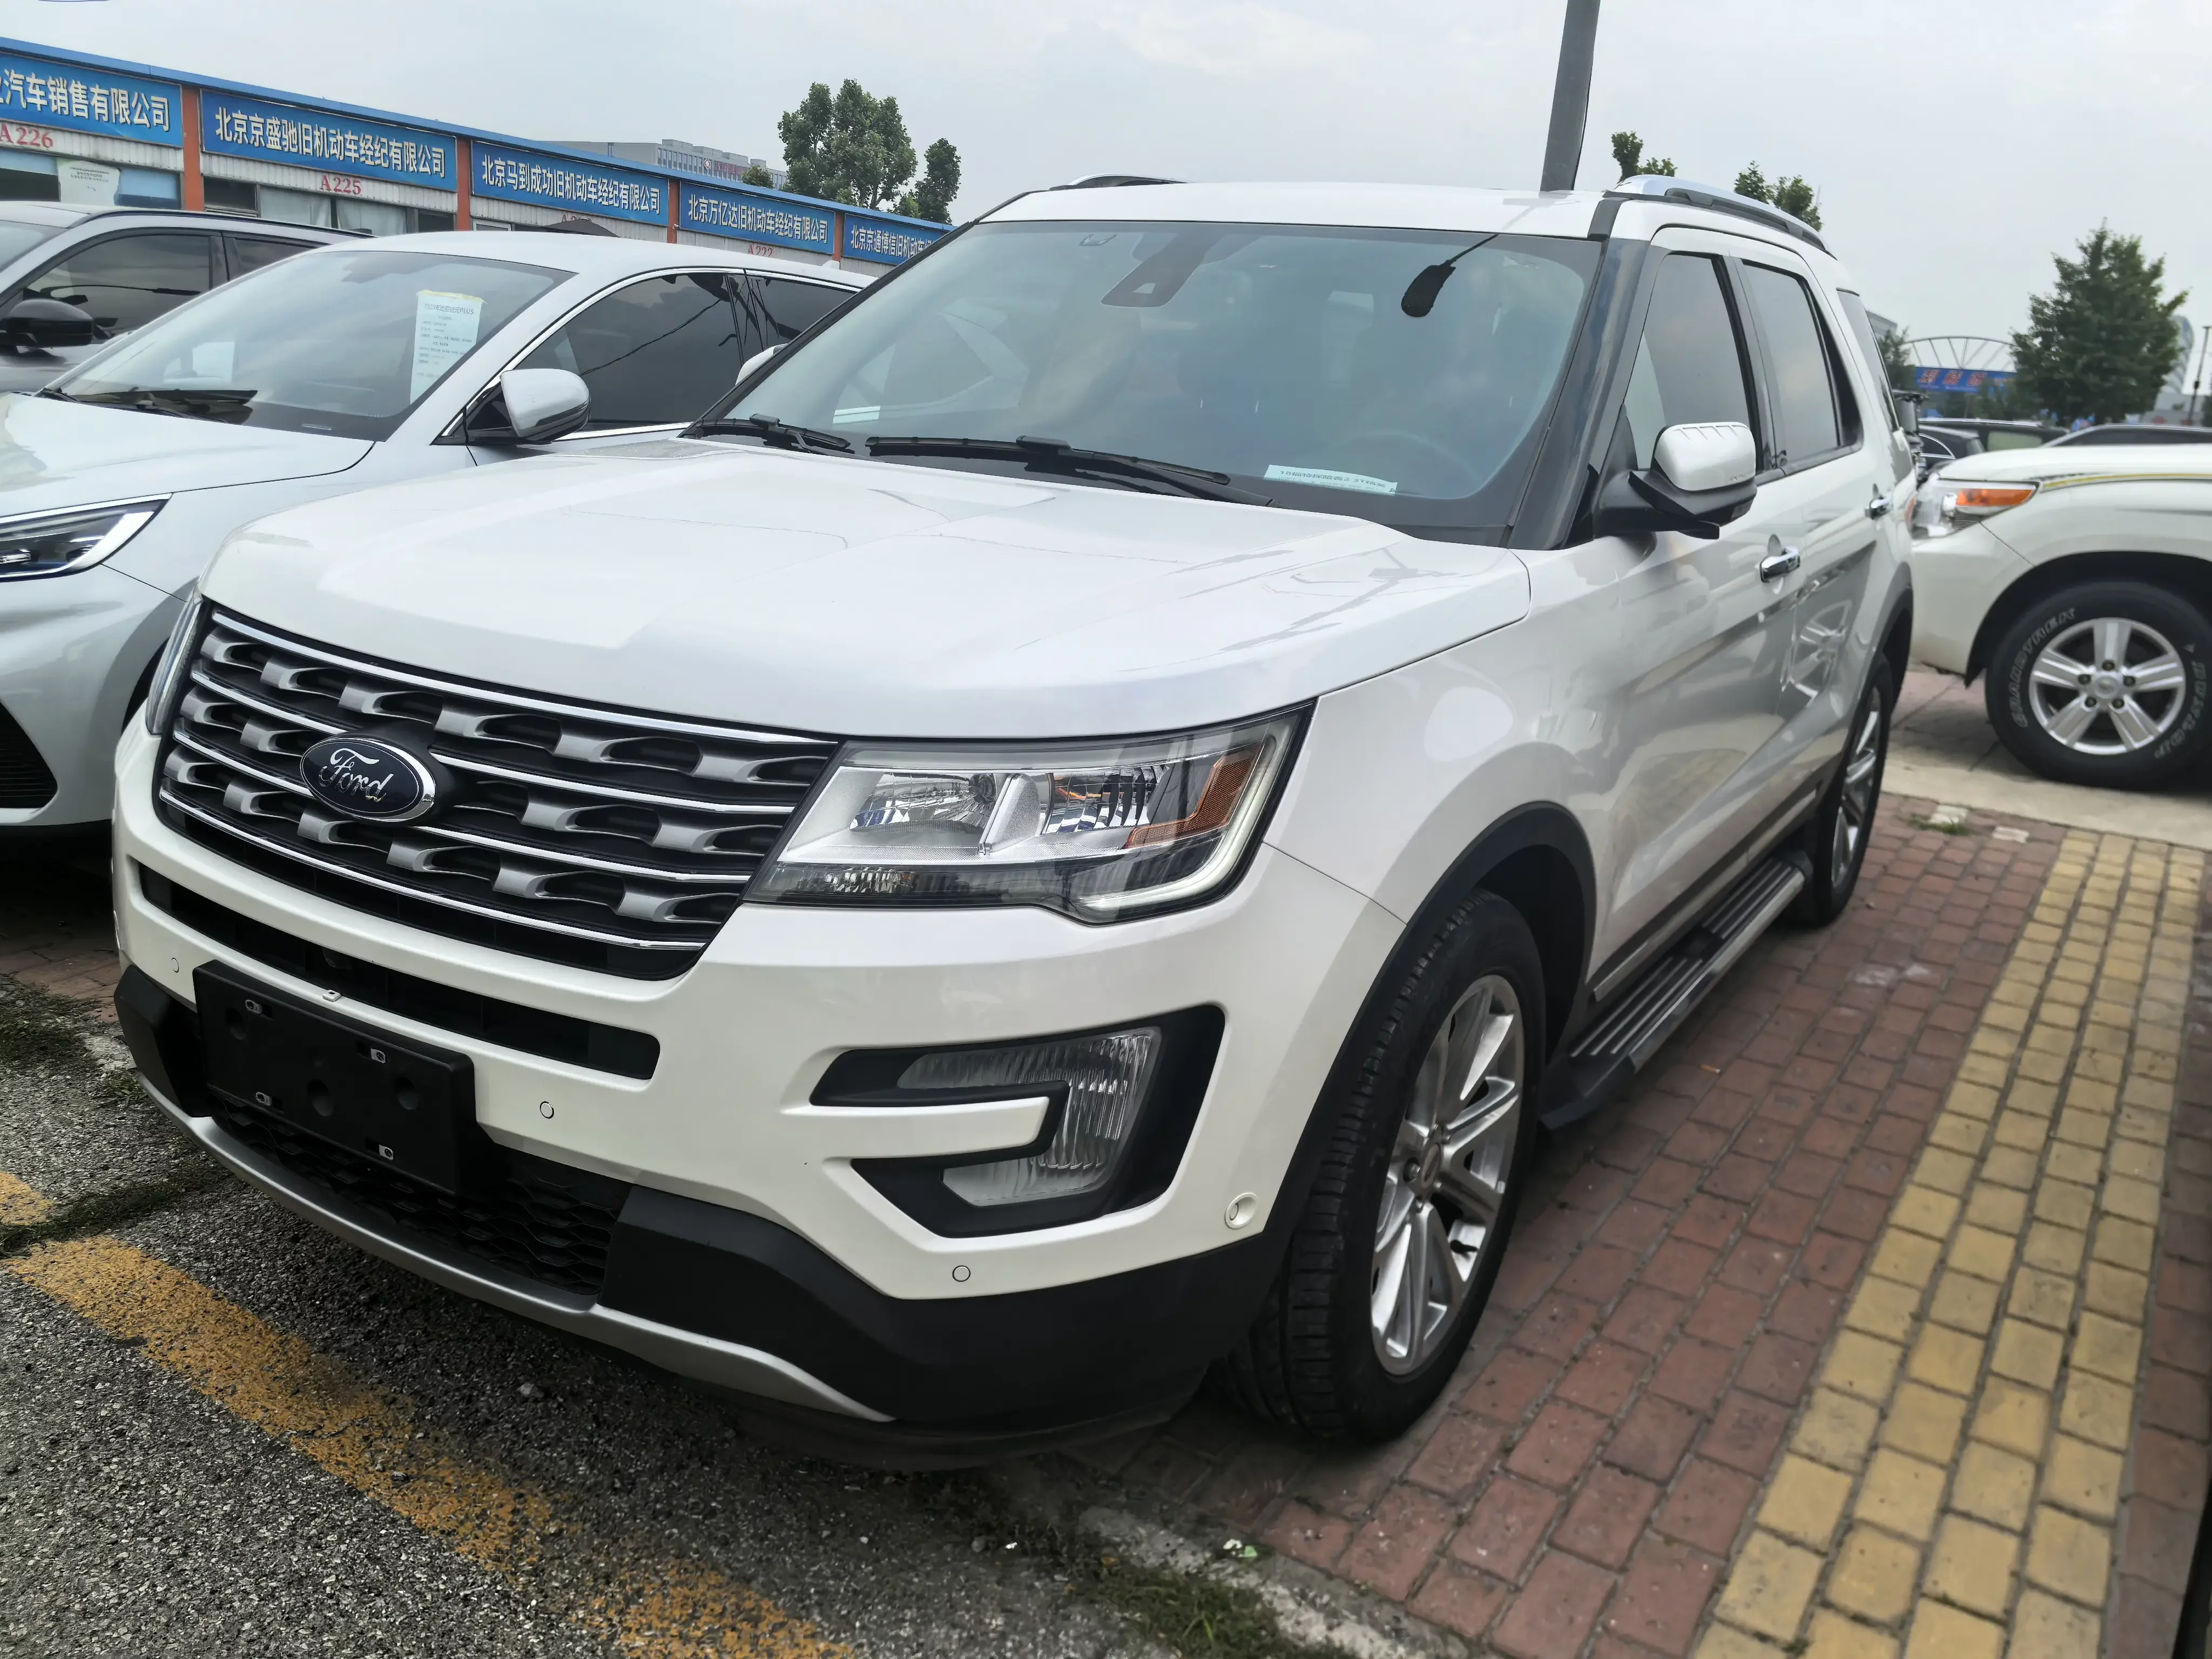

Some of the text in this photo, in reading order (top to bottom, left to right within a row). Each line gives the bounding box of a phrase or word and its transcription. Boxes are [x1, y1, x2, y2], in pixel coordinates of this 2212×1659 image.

[0, 69, 169, 132] 汽车销售有限公司
[0, 123, 53, 148] A226
[215, 107, 446, 178] 北京京盛驰旧机动车经纪有限公司
[320, 174, 361, 195] A225
[482, 154, 660, 214] 北京马到成功旧机动车经纪有限公司
[689, 193, 827, 243] 北京万亿达旧机动车经纪有限公司
[319, 748, 394, 802] Ford
